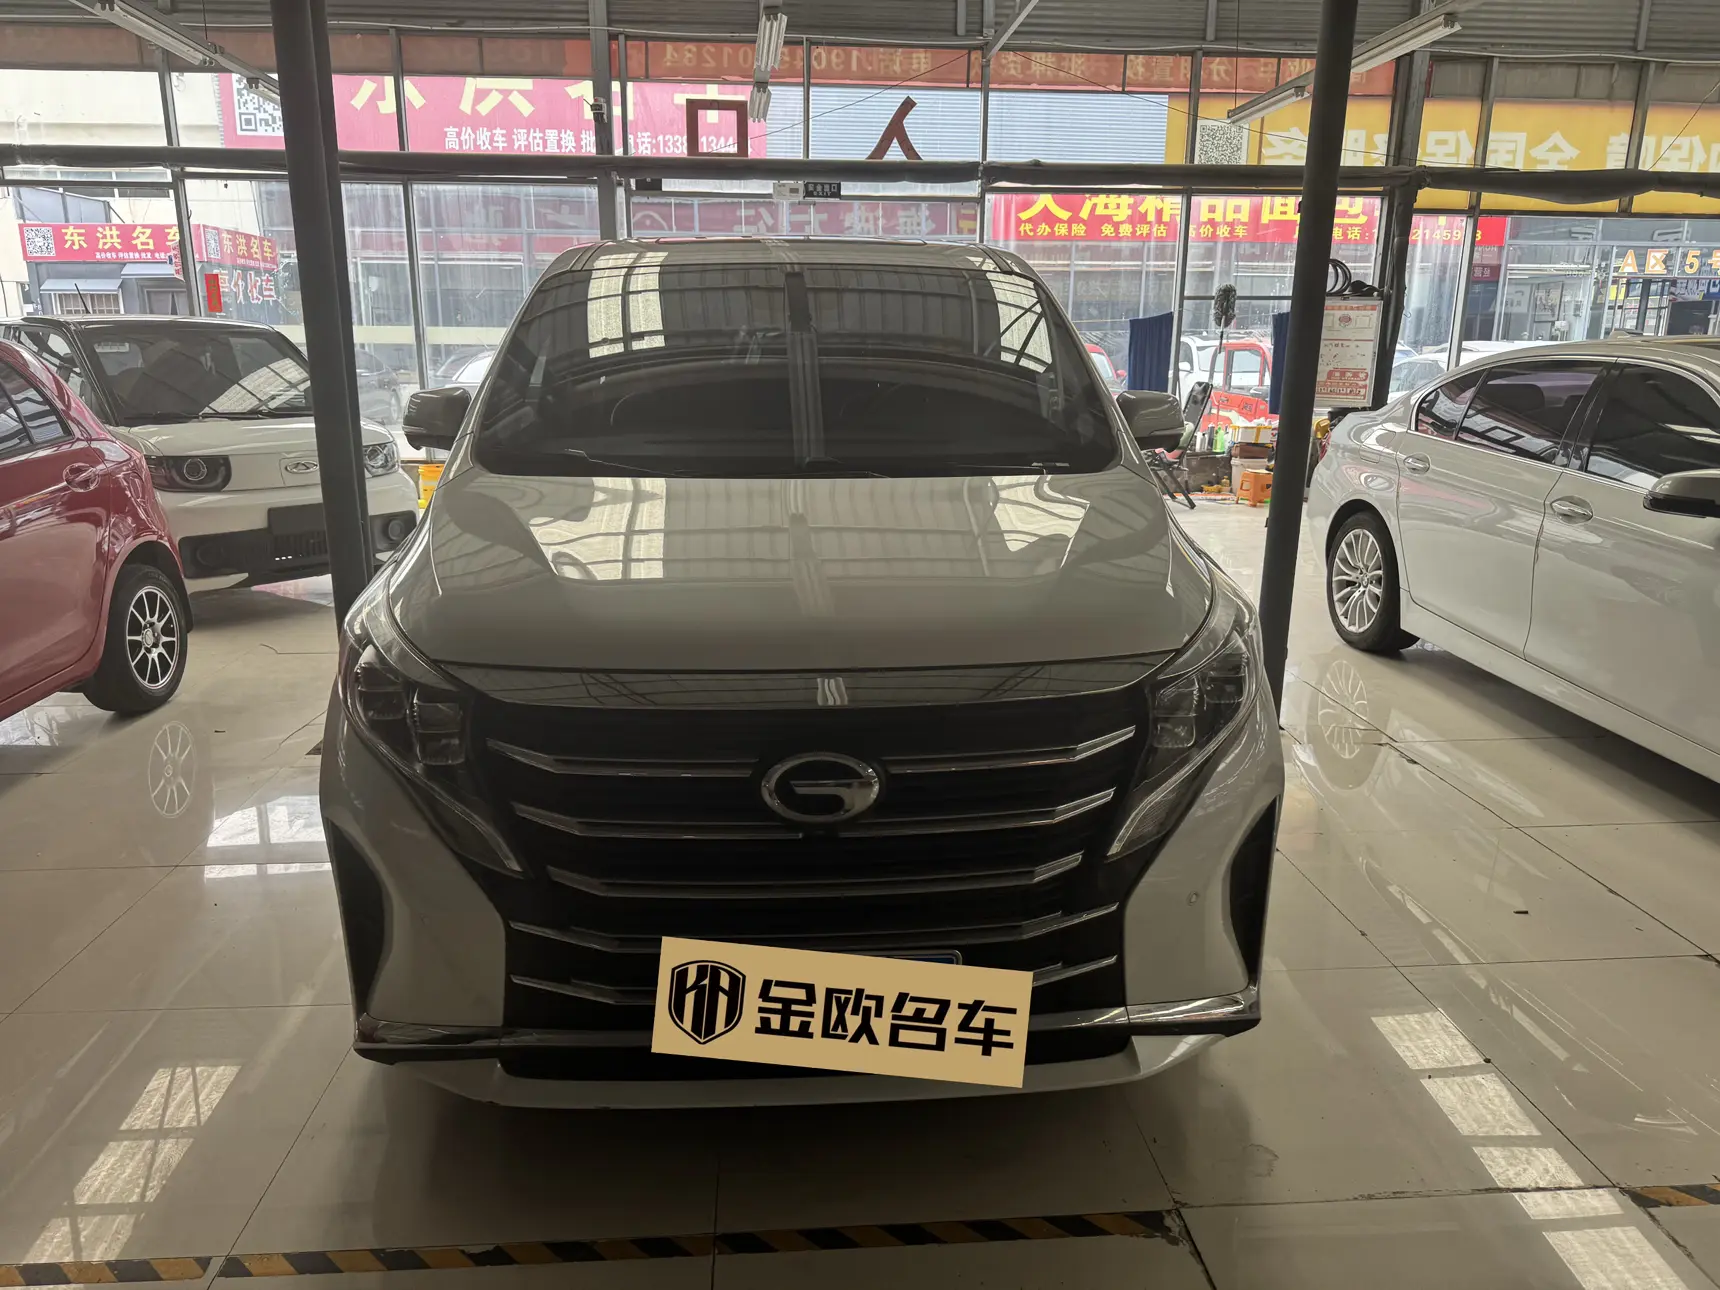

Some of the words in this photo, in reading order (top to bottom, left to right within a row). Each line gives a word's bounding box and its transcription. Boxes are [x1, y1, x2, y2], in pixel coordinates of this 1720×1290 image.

[444, 127, 507, 151] 高价收车
[512, 129, 577, 153] 评估置换
[1019, 222, 1087, 237] 代办保险
[1100, 223, 1168, 238] 免费评估
